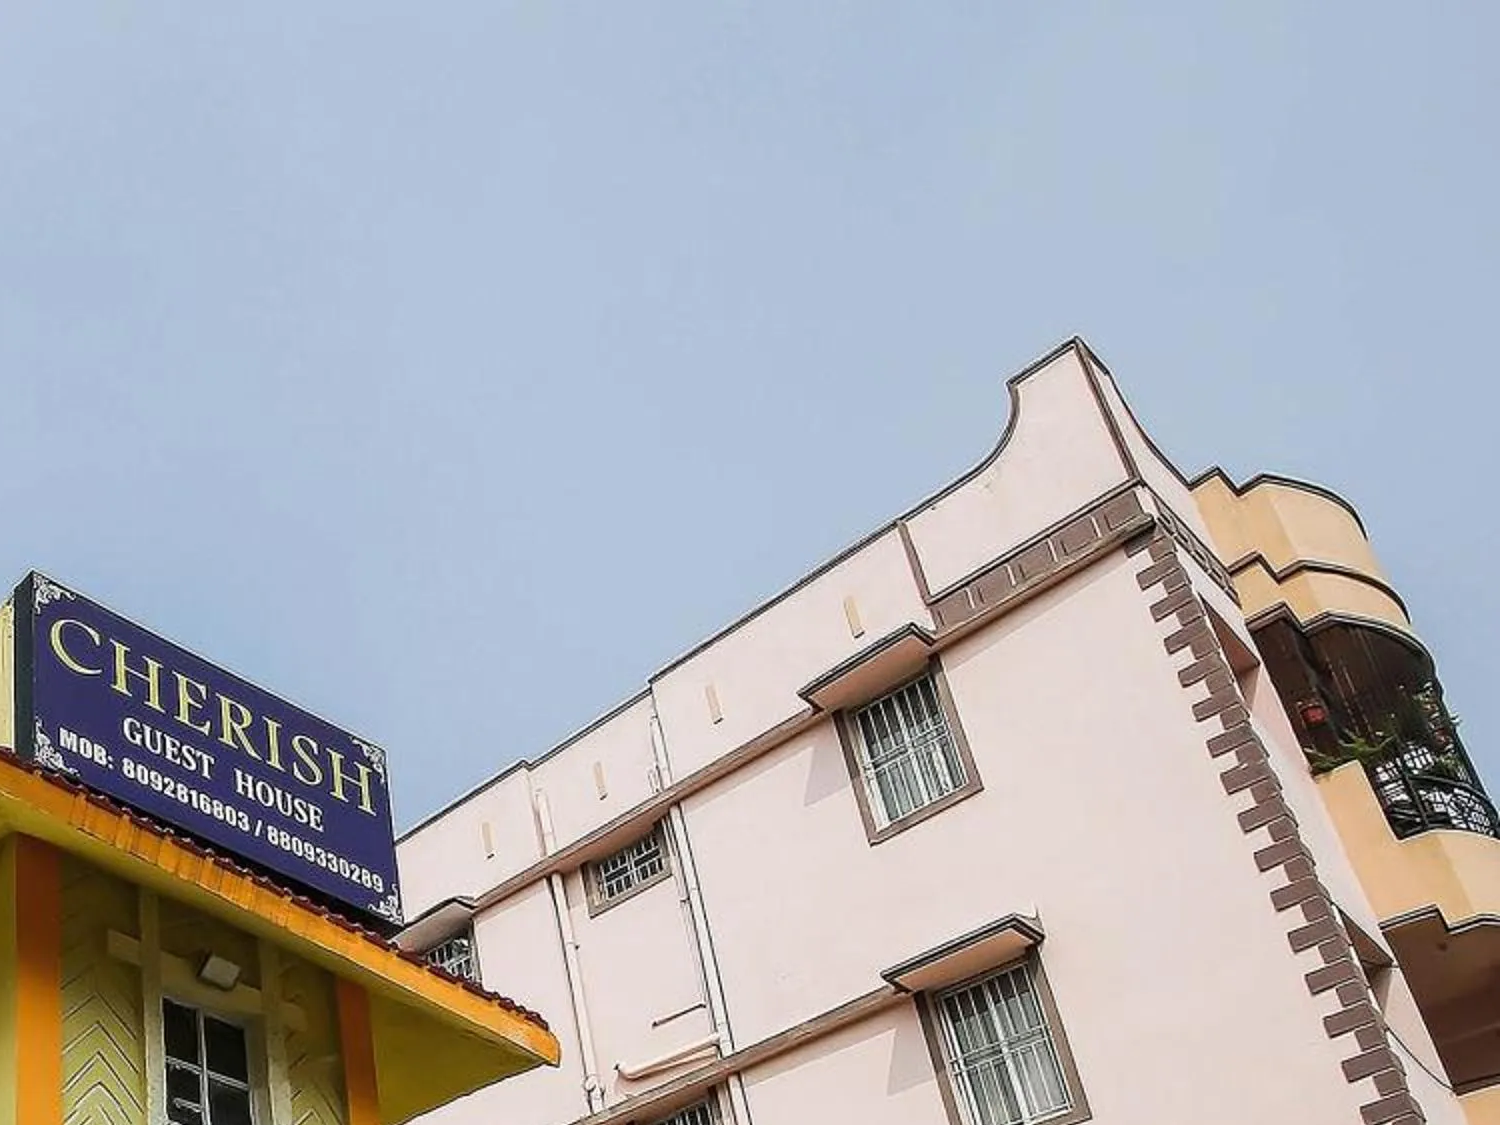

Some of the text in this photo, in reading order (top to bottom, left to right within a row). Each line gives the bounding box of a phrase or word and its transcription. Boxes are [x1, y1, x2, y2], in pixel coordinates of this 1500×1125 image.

[49, 618, 378, 817] CHERISH
[123, 716, 325, 833] GUEST HOUSE
[59, 727, 384, 894] MOB: 8092816803 / 8809330289
